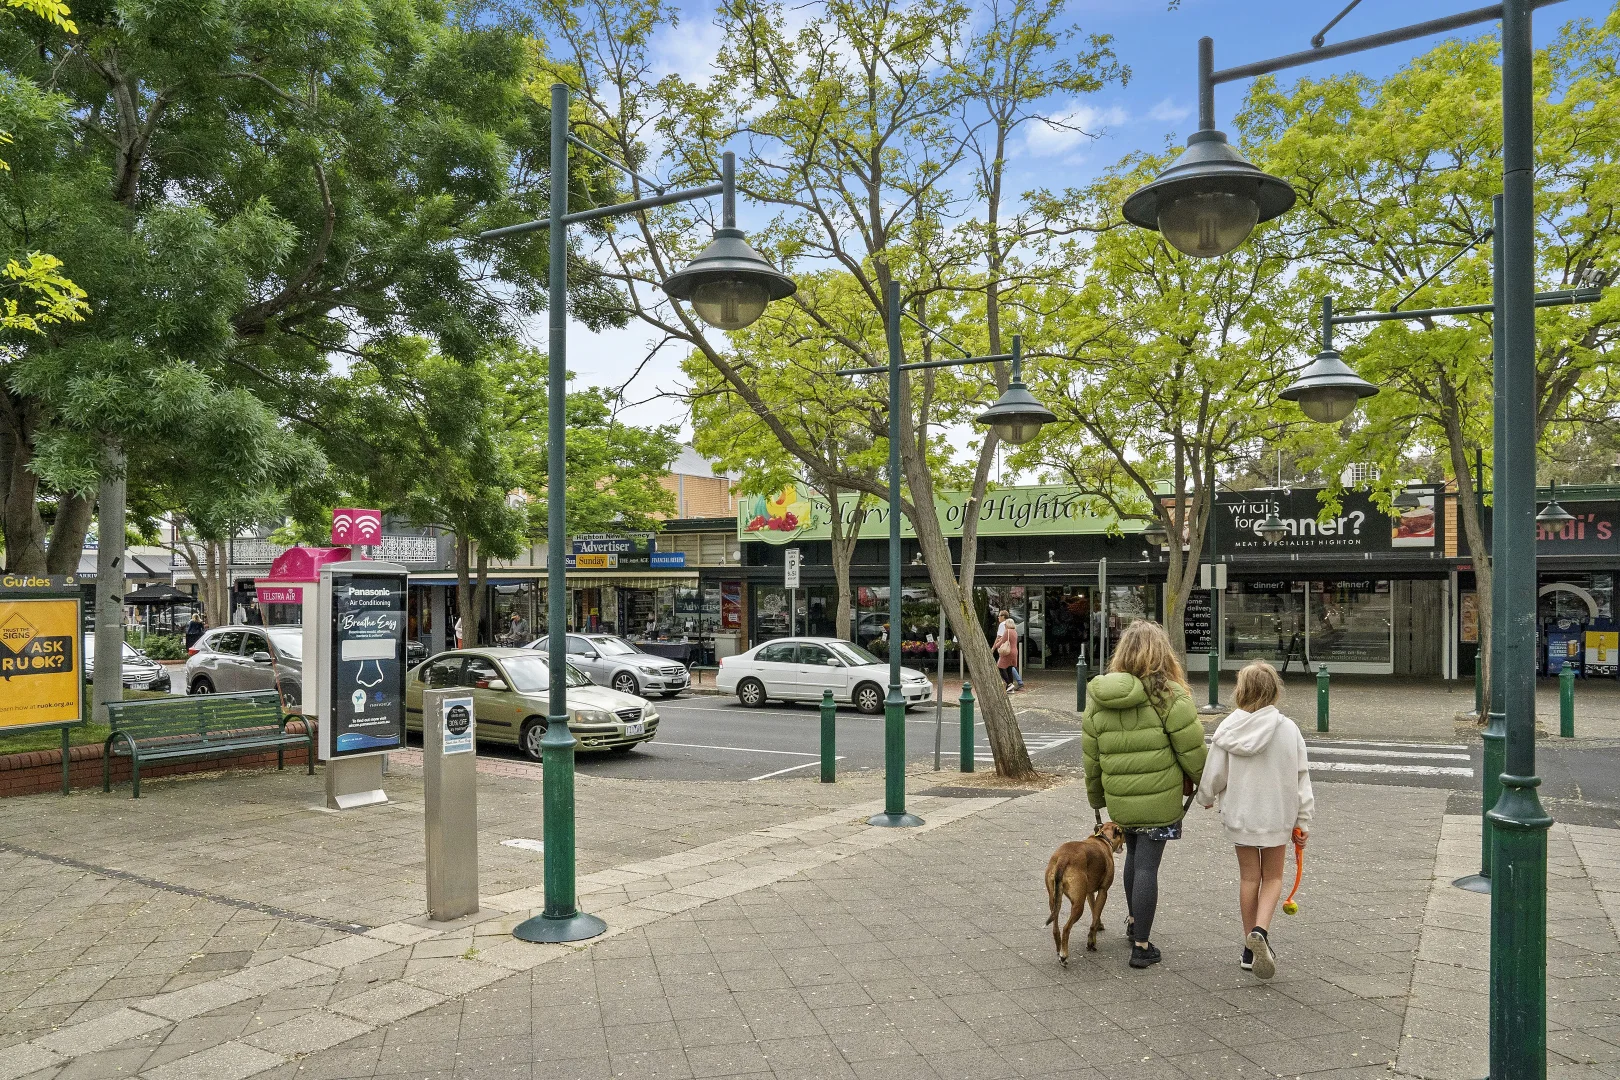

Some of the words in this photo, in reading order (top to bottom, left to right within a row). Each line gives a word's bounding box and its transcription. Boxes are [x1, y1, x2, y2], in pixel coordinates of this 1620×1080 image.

[1235, 516, 1253, 528] for
[1253, 510, 1365, 537] dnner?
[576, 533, 604, 541] Highton
[580, 541, 630, 553] Advertiser
[578, 557, 606, 567] Sunday
[3, 576, 51, 588] Guides
[1253, 581, 1284, 589] dinner?
[1336, 580, 1370, 589] dinner?
[348, 587, 391, 596] Panasonic
[263, 593, 285, 601] TELSTRA
[359, 600, 391, 608] Conditioning
[342, 614, 377, 630] Breathe
[377, 614, 397, 631] Easy
[3, 632, 30, 640] SIGNS
[31, 640, 63, 654] ASK
[3, 658, 14, 671] R
[17, 657, 29, 670] U
[32, 655, 65, 669] OK?
[37, 701, 74, 709] ruok.org.au
